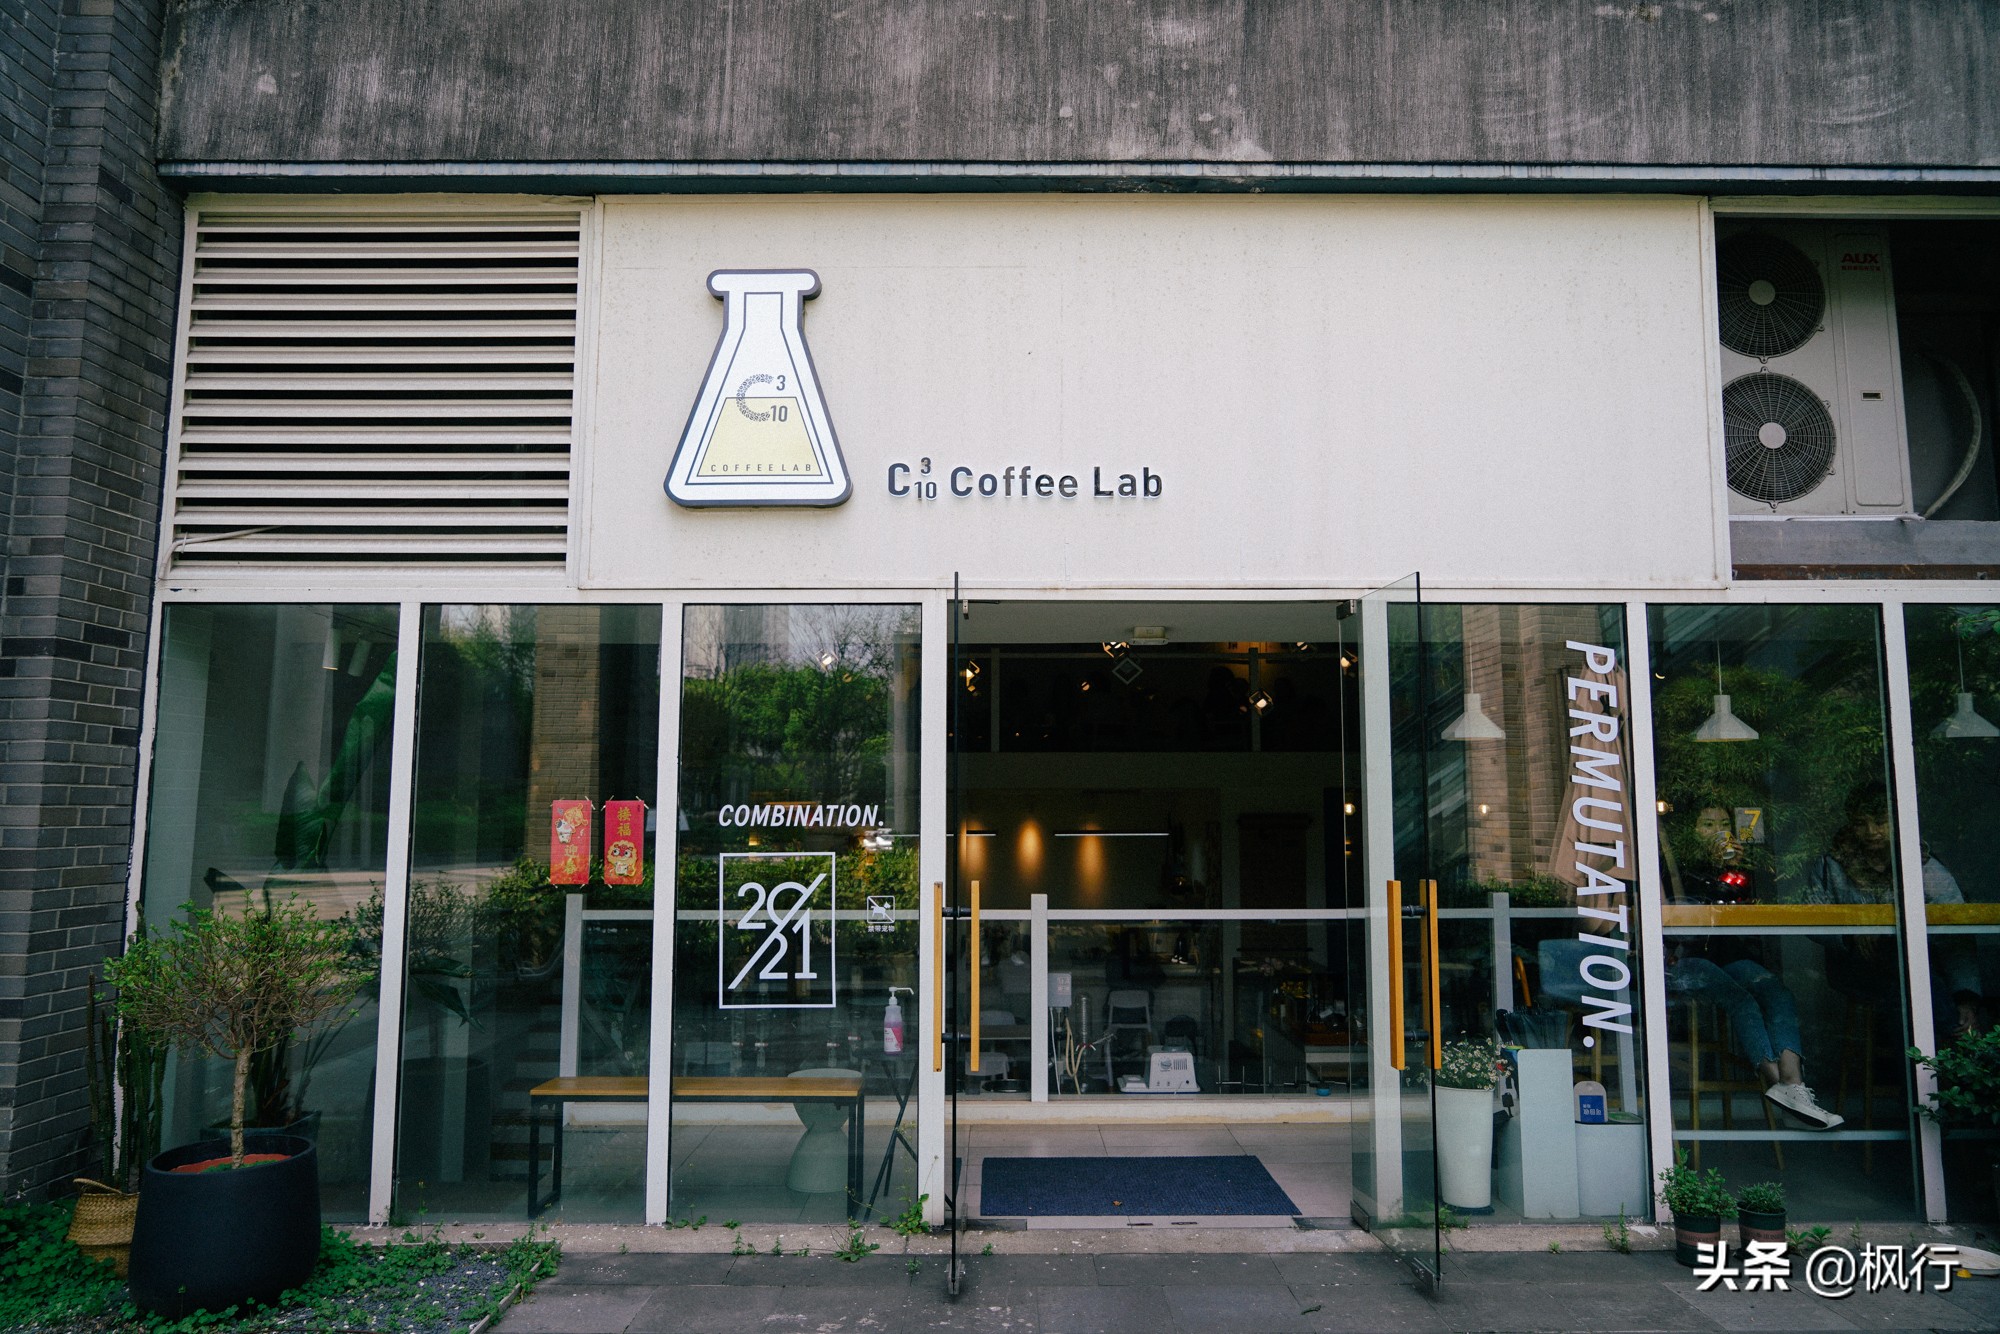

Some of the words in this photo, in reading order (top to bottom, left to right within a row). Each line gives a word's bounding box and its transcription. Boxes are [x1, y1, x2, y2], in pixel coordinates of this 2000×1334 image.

[1841, 253, 1879, 264] AUX
[770, 405, 788, 422] 10
[950, 466, 1079, 498] Coffee
[1093, 466, 1163, 498] Lab
[718, 804, 885, 828] COMBINATION.
[1565, 640, 1634, 1049] PERMUTATION.
